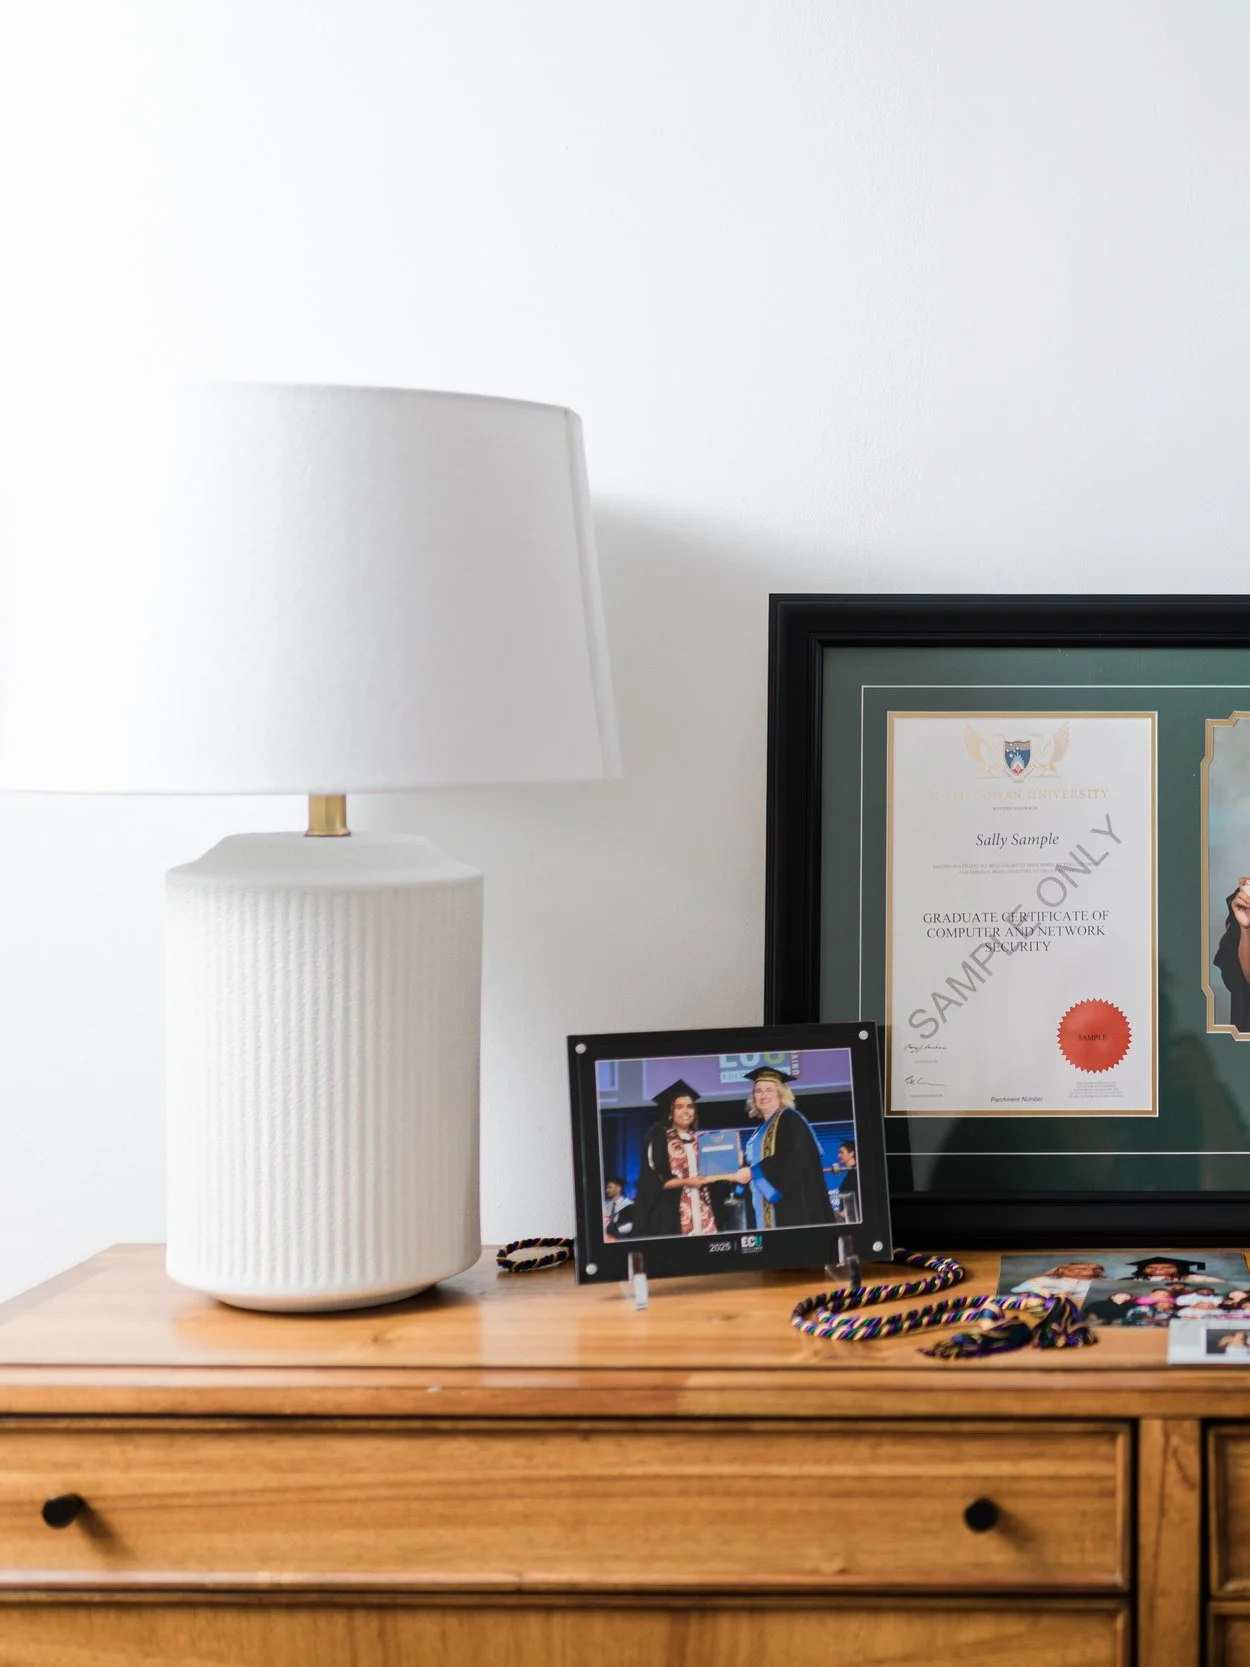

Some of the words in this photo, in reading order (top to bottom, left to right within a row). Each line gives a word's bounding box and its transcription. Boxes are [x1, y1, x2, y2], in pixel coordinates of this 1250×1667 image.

[975, 833, 1008, 849] Sally
[1011, 833, 1060, 849] Sample
[922, 912, 998, 923] GRADUATE
[1001, 911, 1089, 922] CERTIFICATE
[1092, 910, 1110, 921] OF
[908, 904, 1041, 1040] SAMPLE
[1036, 813, 1122, 908] ONLY
[926, 927, 1001, 938] COMPUTER
[1005, 926, 1035, 937] AND
[1038, 925, 1106, 937] NETWORK
[984, 941, 1051, 953] SECURITY
[709, 1241, 731, 1253] 2025
[741, 1235, 763, 1248] ECU
